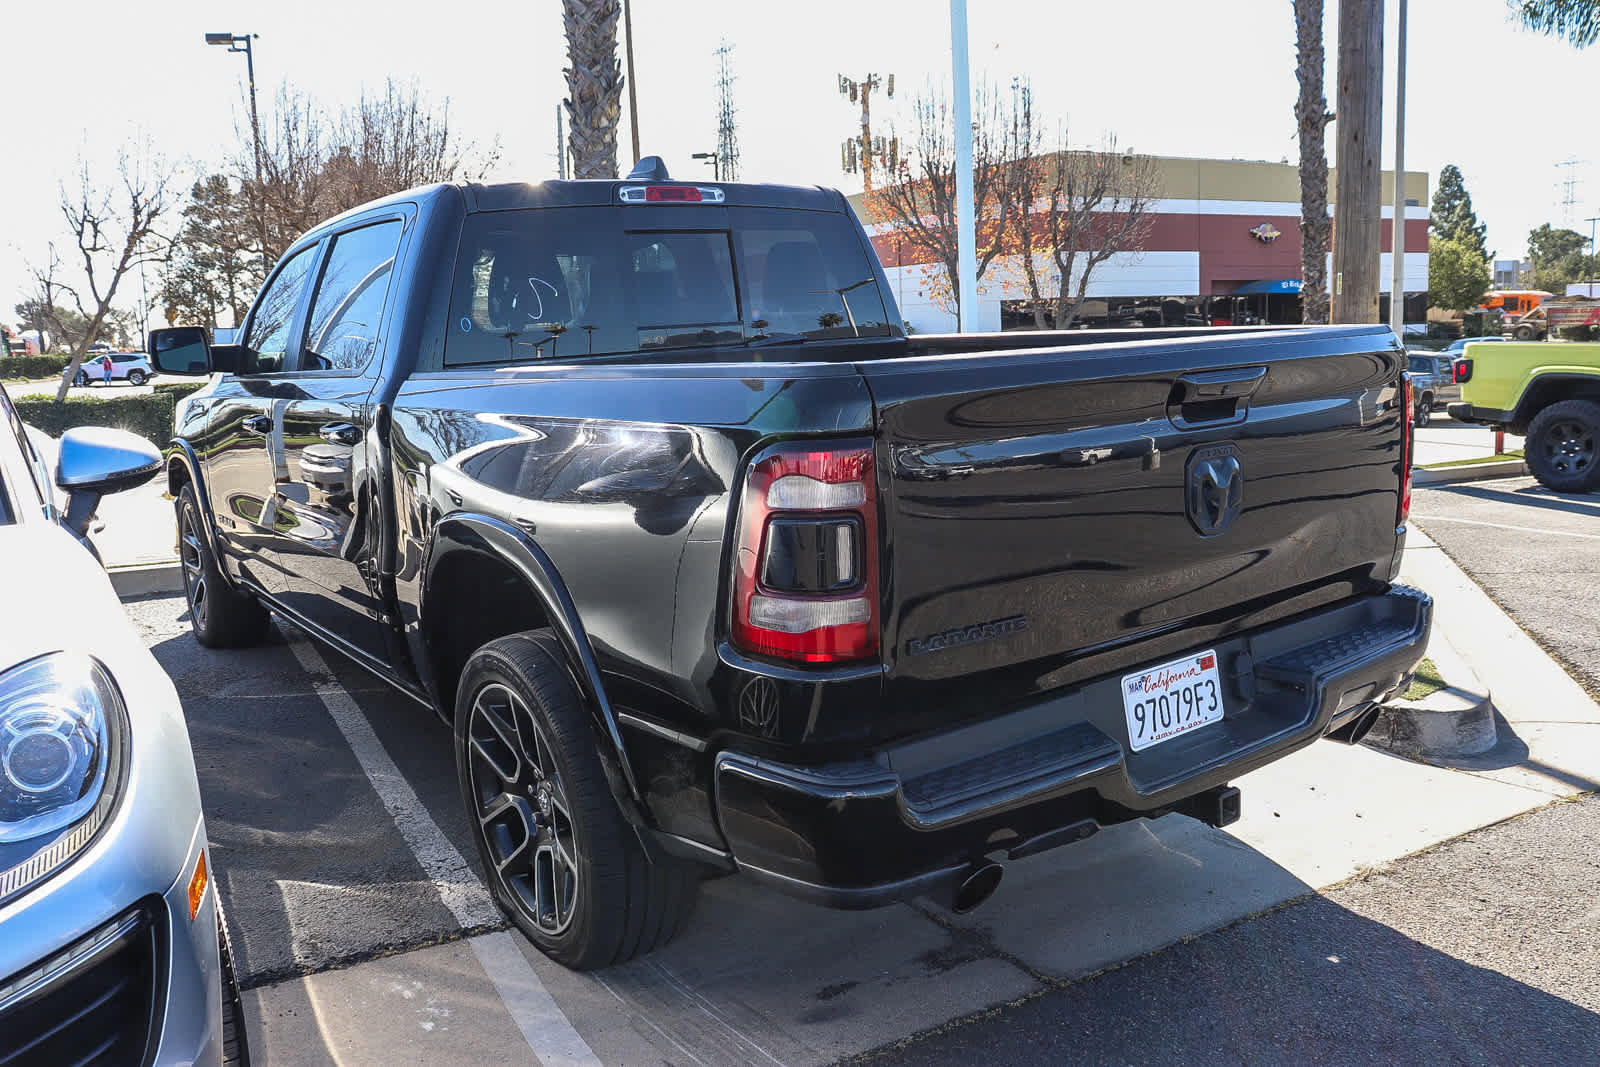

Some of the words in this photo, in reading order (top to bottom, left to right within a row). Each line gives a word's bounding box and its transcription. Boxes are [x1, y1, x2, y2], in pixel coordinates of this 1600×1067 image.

[909, 615, 1028, 656] LARAMIE
[1128, 680, 1143, 693] MAR
[1144, 665, 1201, 694] California
[1134, 679, 1218, 739] 97079F3
